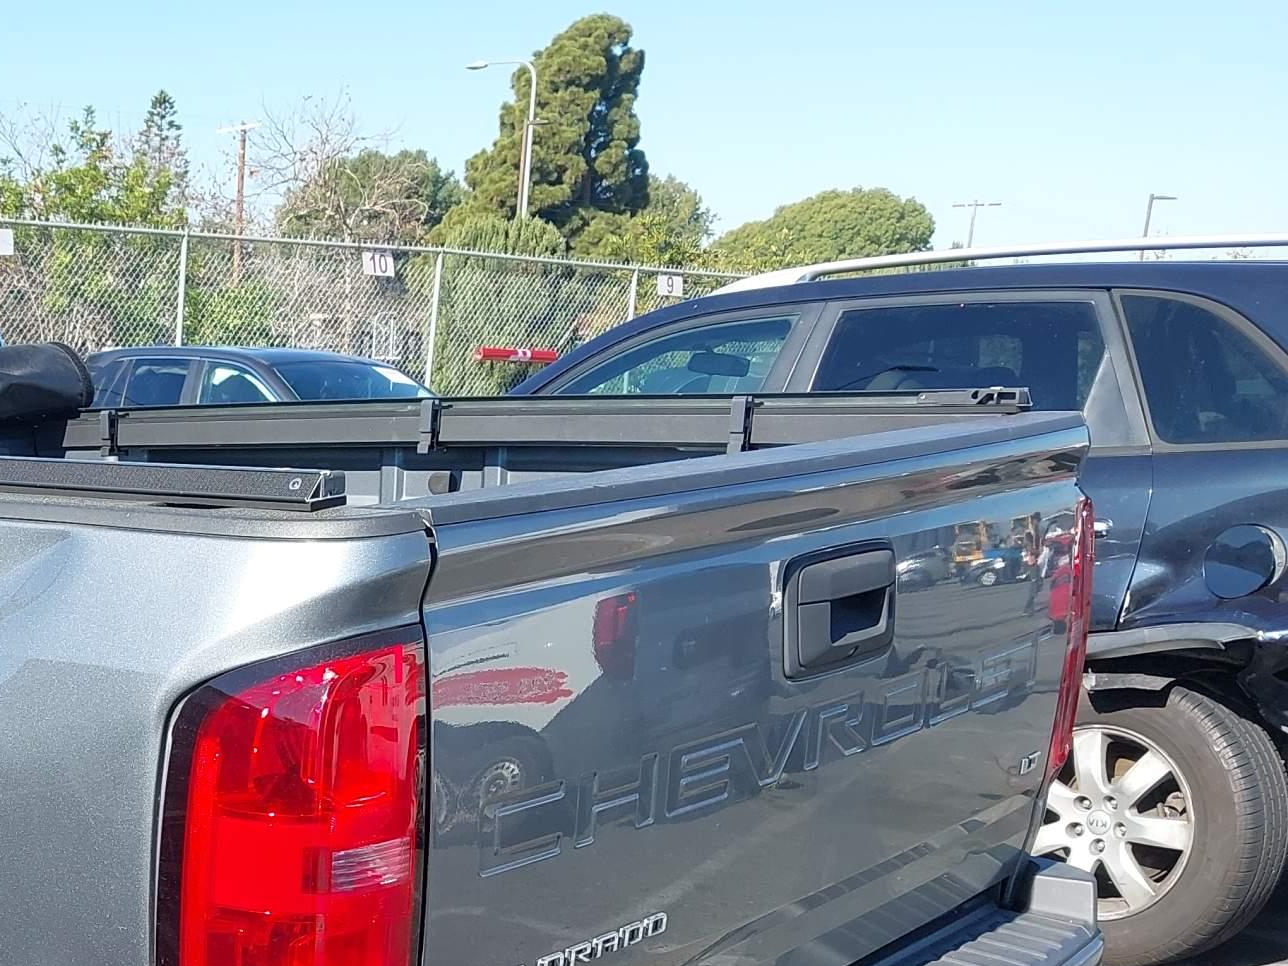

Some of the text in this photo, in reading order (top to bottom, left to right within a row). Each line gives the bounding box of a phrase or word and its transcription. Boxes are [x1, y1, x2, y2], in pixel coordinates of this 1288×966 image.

[369, 251, 387, 274] 10
[666, 276, 674, 294] 9
[478, 622, 1054, 878] CHEVROLET
[1088, 816, 1108, 829] KIA
